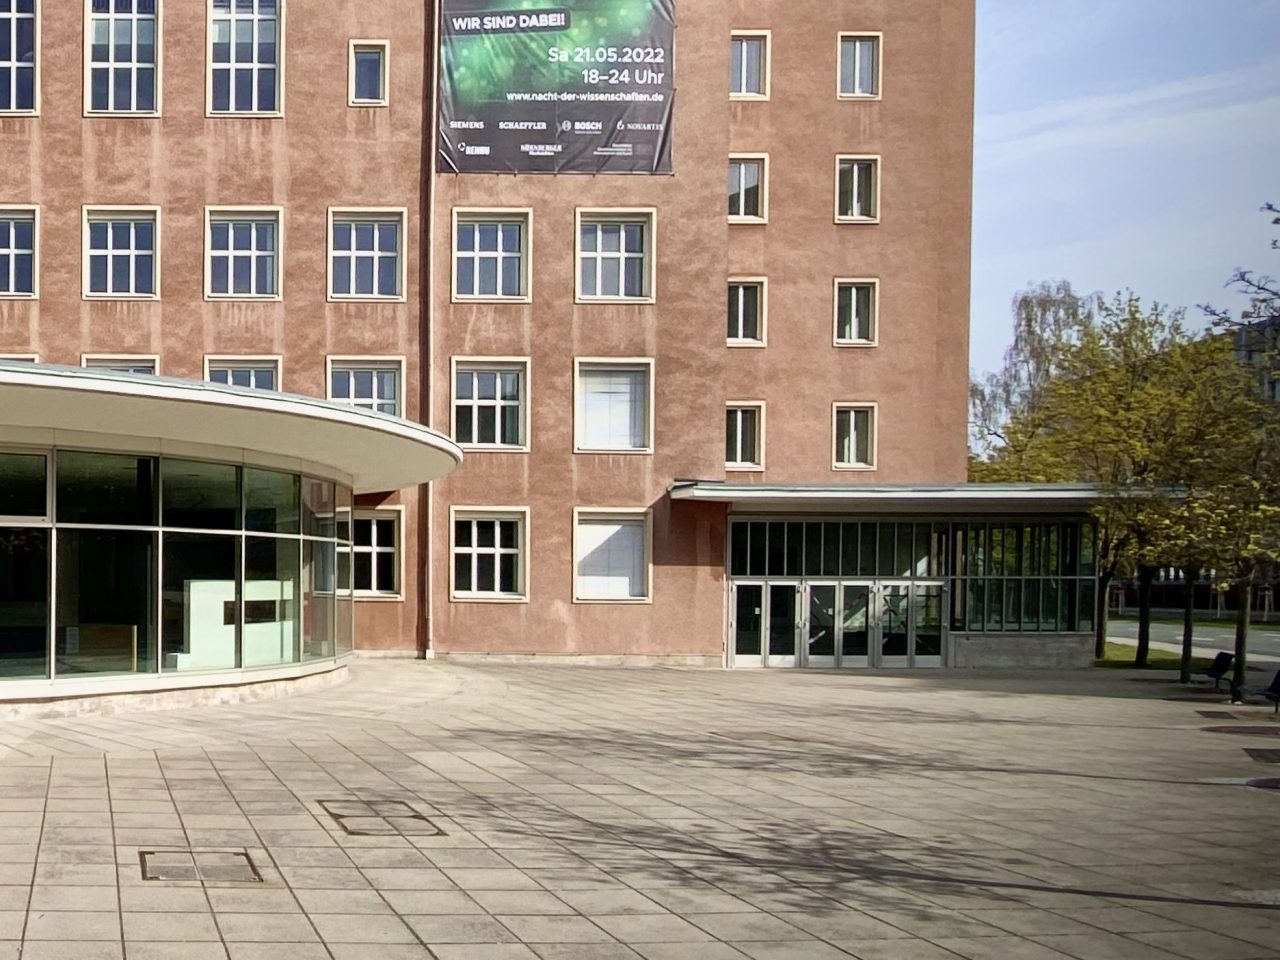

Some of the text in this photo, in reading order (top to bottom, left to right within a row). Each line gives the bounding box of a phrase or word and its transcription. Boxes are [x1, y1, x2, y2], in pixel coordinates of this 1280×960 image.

[453, 13, 566, 31] WIR SIND DABEI!
[548, 48, 665, 63] Sa 21.05.2022
[634, 69, 665, 84] Uhr
[506, 92, 664, 102] www.nacht-der-wissenschaften.de
[449, 121, 484, 129] SIEMENS
[499, 122, 547, 130] SCHAEFFLER
[574, 122, 602, 130] BOSCH
